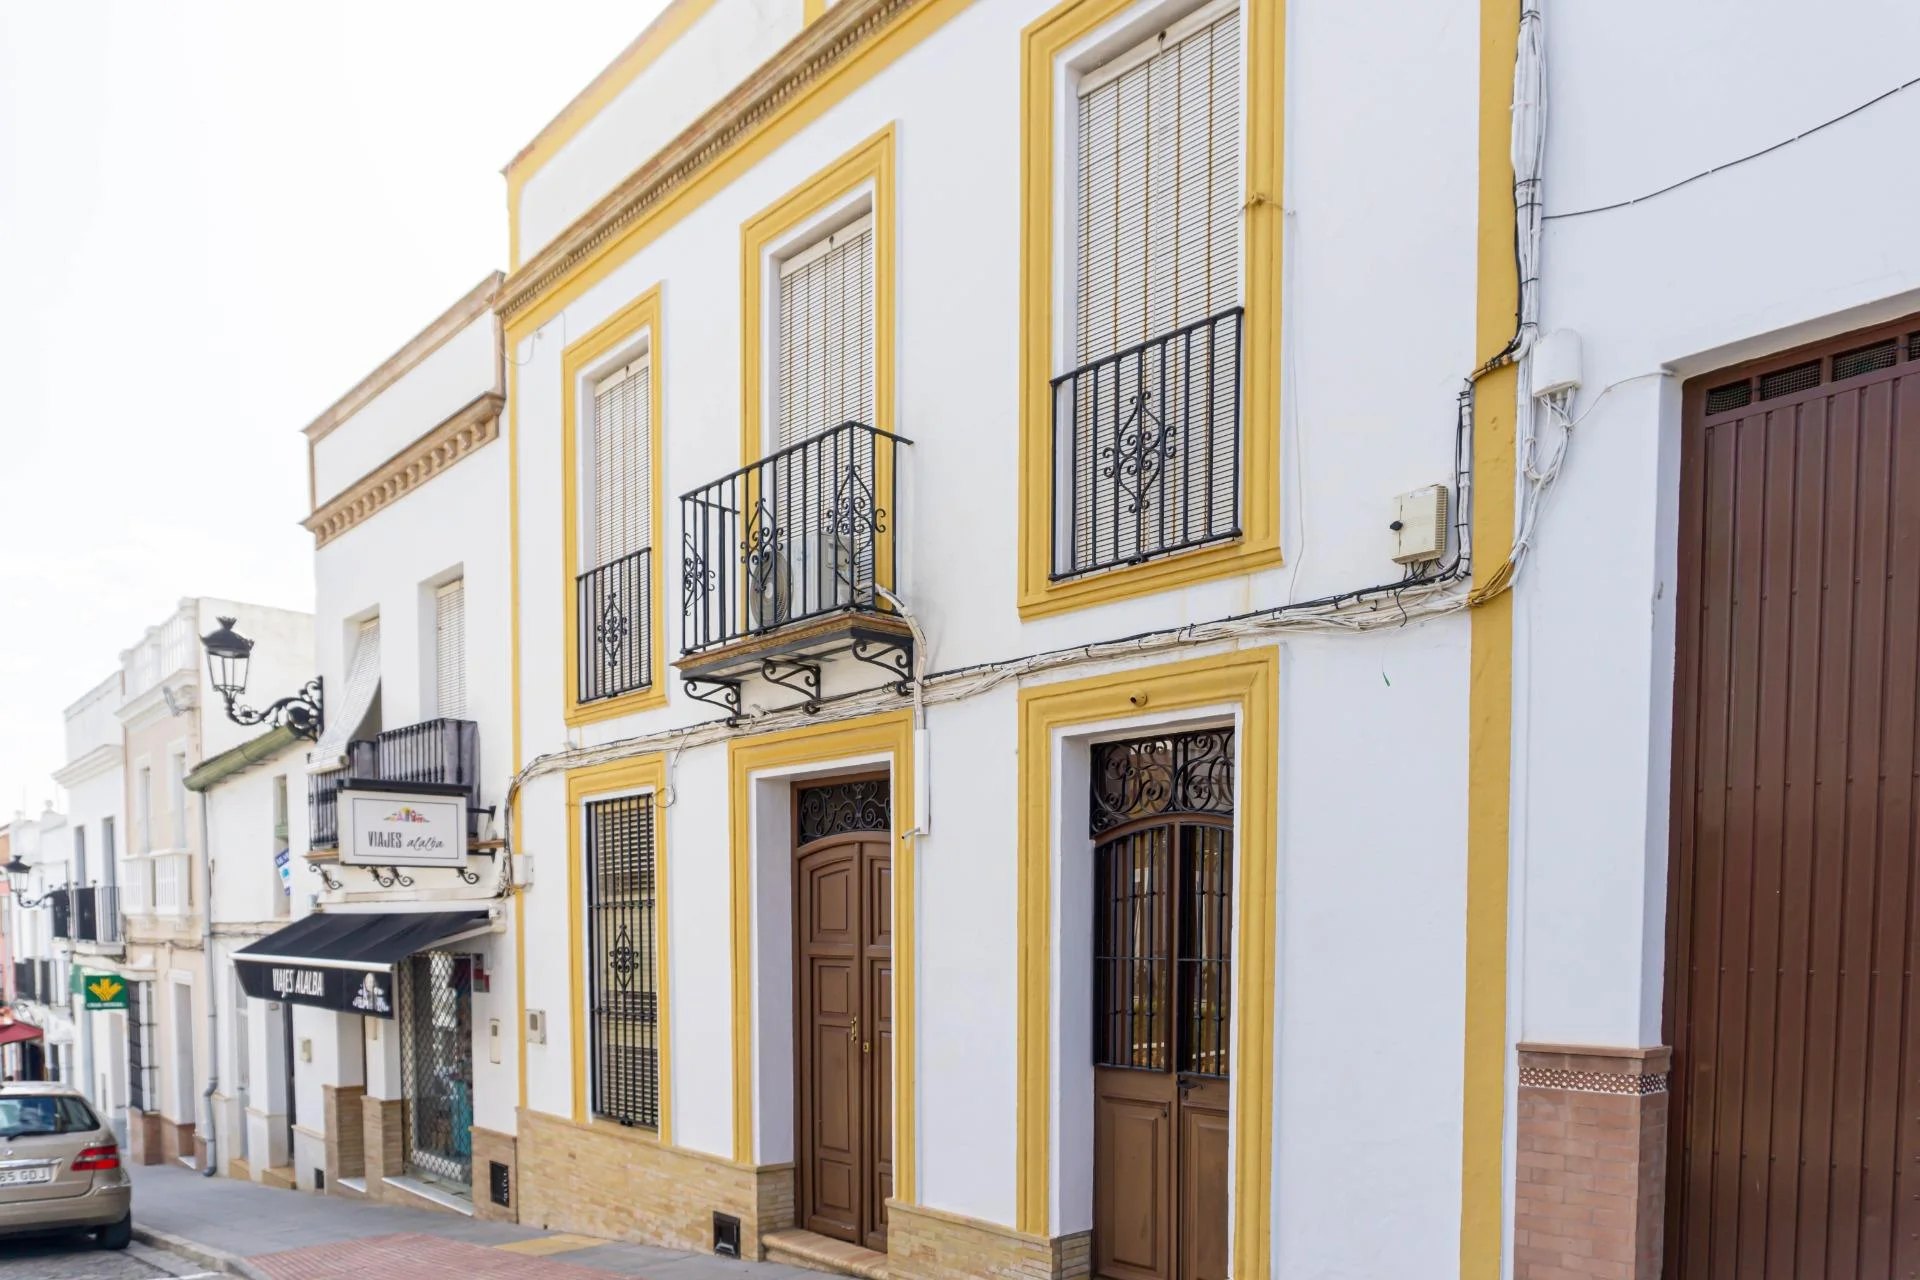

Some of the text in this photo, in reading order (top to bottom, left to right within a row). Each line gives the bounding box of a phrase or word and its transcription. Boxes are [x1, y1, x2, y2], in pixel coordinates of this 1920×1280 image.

[368, 831, 402, 848] VIAJES
[272, 968, 325, 998] VIAJES ALALBA
